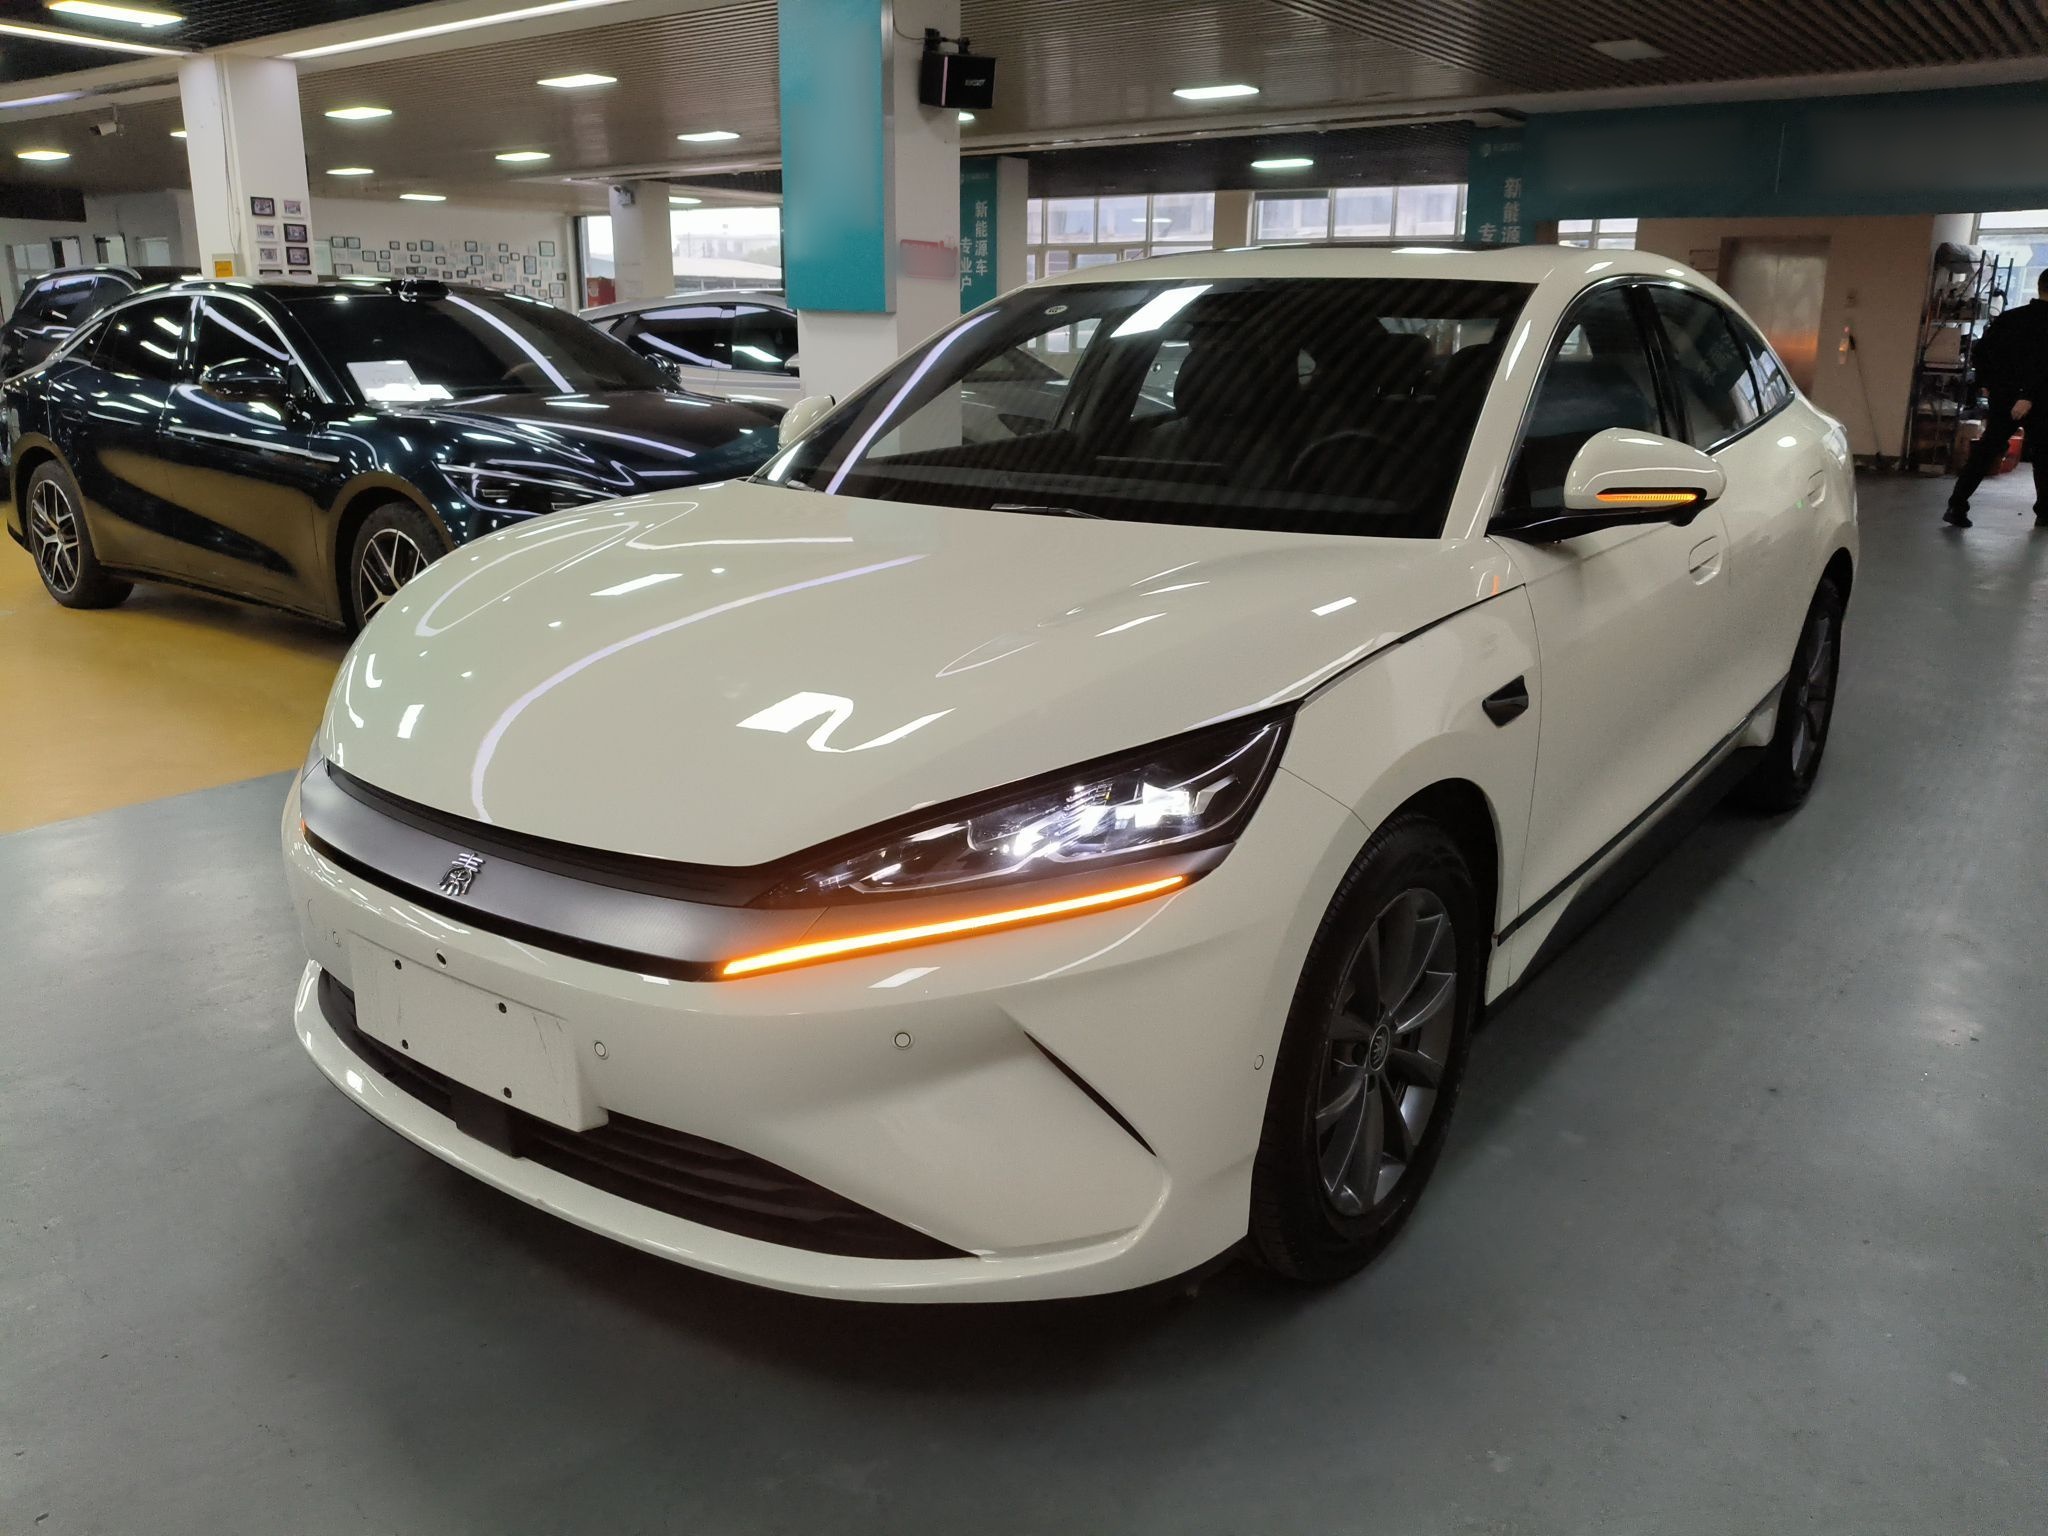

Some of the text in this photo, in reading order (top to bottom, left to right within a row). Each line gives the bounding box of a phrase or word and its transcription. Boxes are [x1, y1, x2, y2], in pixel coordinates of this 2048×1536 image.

[975, 201, 988, 276] 新能源车
[1479, 223, 1498, 242] 专
[960, 237, 973, 292] 专业户
